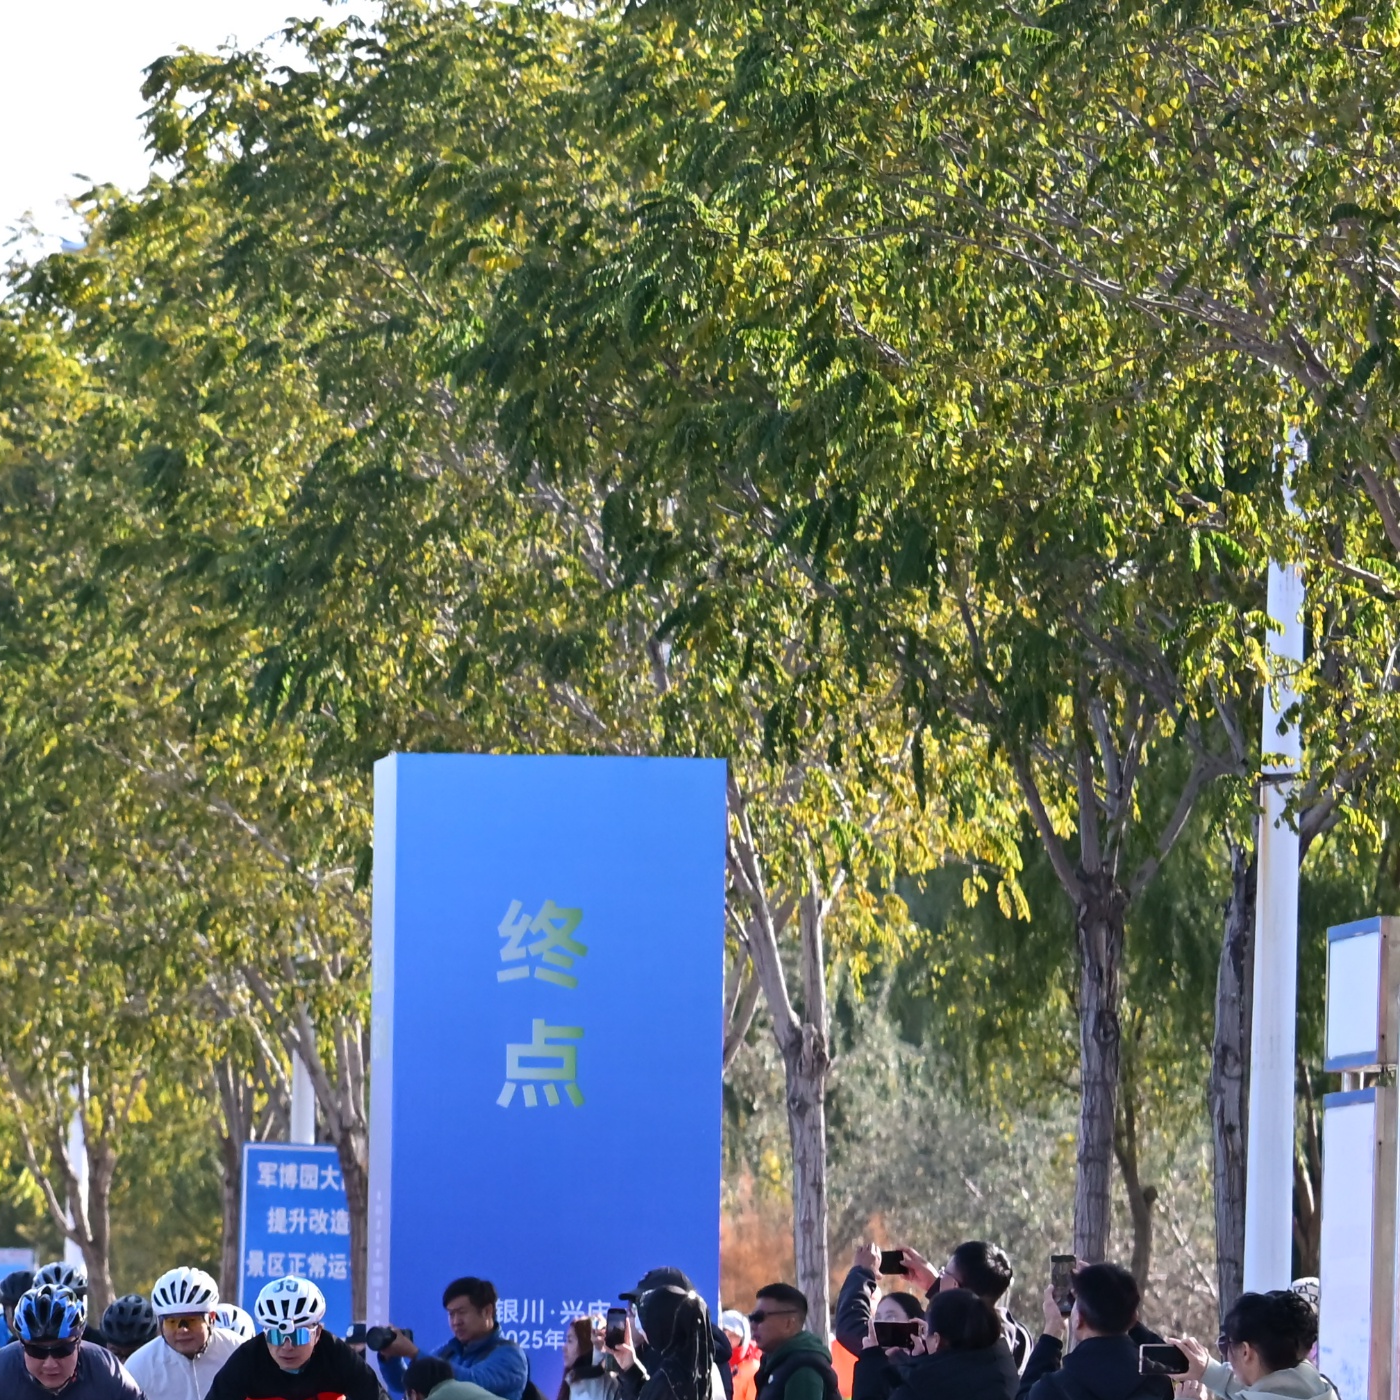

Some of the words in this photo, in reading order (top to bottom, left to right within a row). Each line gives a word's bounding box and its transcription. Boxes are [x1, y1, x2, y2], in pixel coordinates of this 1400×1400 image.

[497, 898, 588, 1109] 终点
[257, 1162, 346, 1191] 军博园大
[267, 1207, 350, 1235] 提升改造
[246, 1250, 351, 1279] 景区正常运
[500, 1328, 566, 1351] 025年
